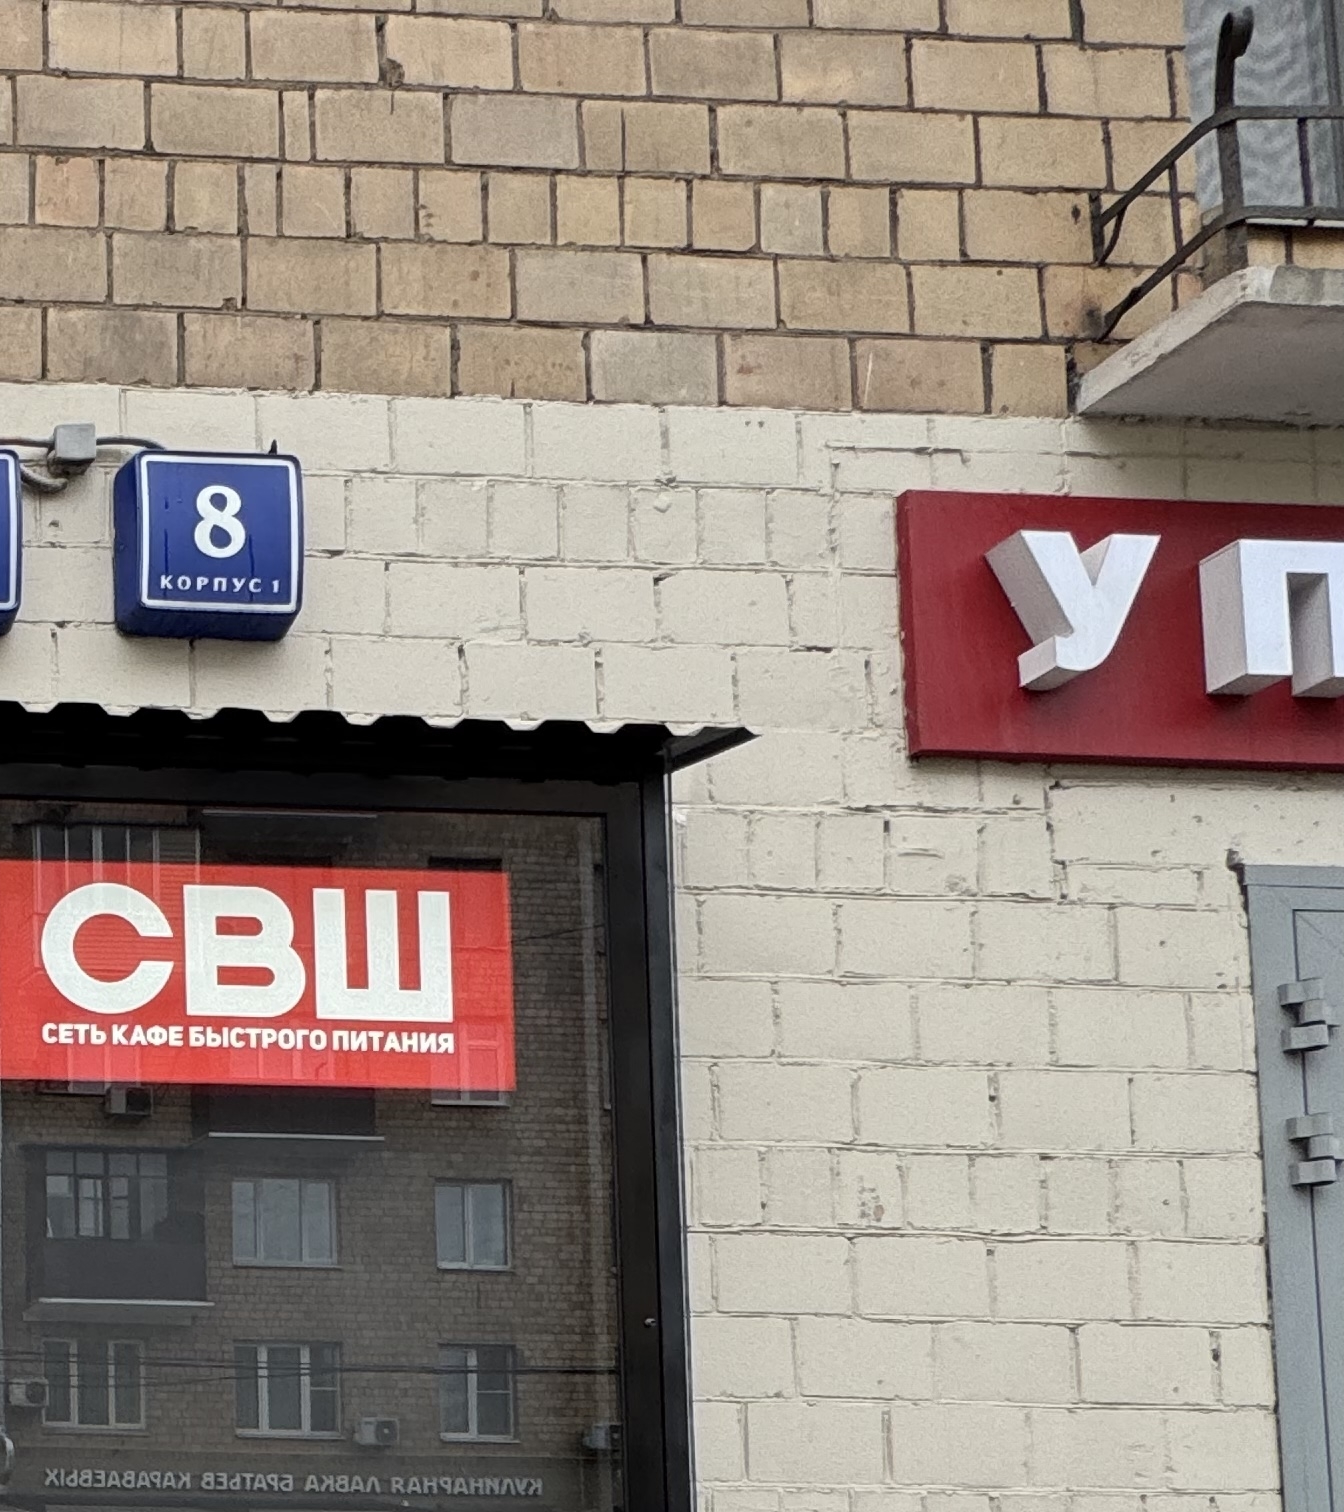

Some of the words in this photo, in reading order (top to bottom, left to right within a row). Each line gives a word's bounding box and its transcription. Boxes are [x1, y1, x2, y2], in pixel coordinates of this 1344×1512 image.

[194, 485, 246, 558] 8
[160, 574, 262, 593] КОРПУС
[271, 579, 281, 593] 1
[40, 882, 454, 1022] СВШ
[41, 1022, 107, 1045] СЕТЬ
[111, 1025, 184, 1048] КАФЕ
[189, 1026, 327, 1052] БЫСТРОГО
[331, 1030, 454, 1054] ПИТАНИЯ
